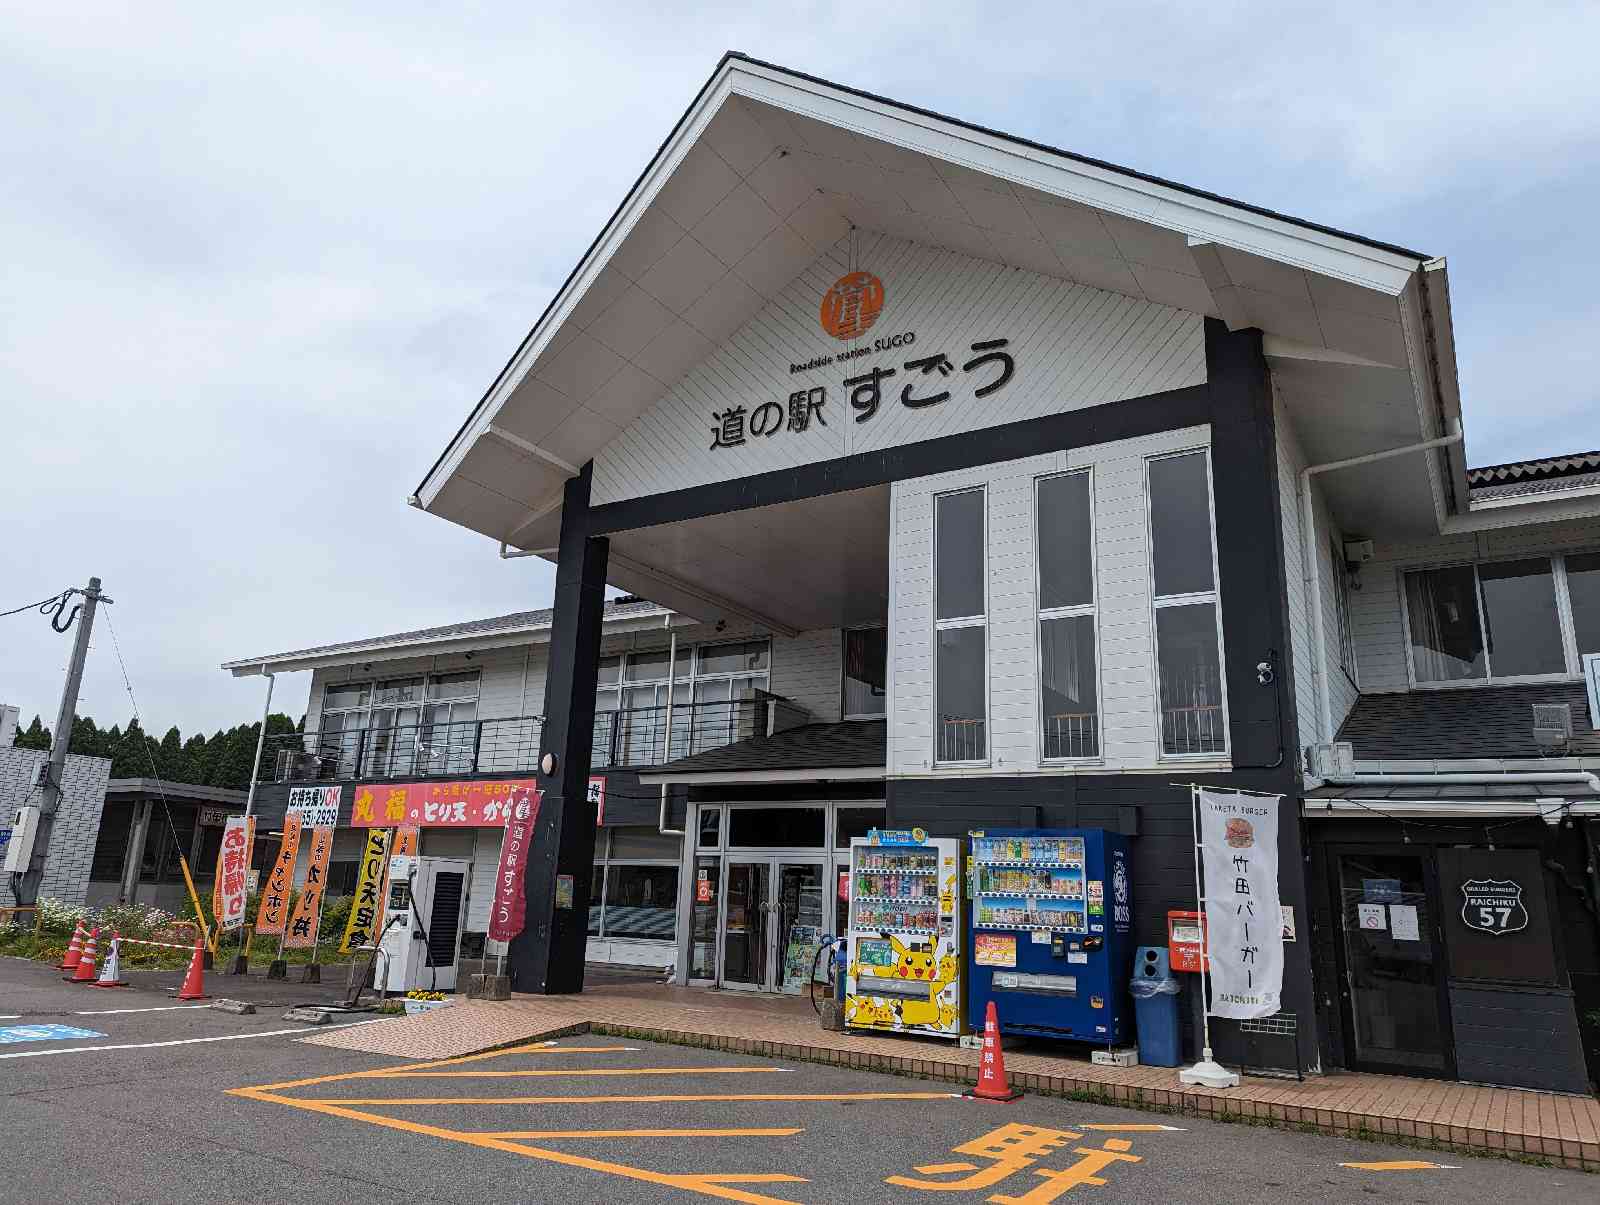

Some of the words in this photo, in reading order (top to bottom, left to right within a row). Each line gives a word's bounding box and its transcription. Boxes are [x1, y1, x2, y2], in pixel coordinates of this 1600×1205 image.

[874, 332, 915, 352] SUGO
[710, 386, 827, 451] 道の駅
[844, 338, 1014, 424] すごう
[1114, 905, 1130, 922] BOSS
[1232, 855, 1257, 989] 竹田バーガー
[1480, 907, 1511, 928] 57
